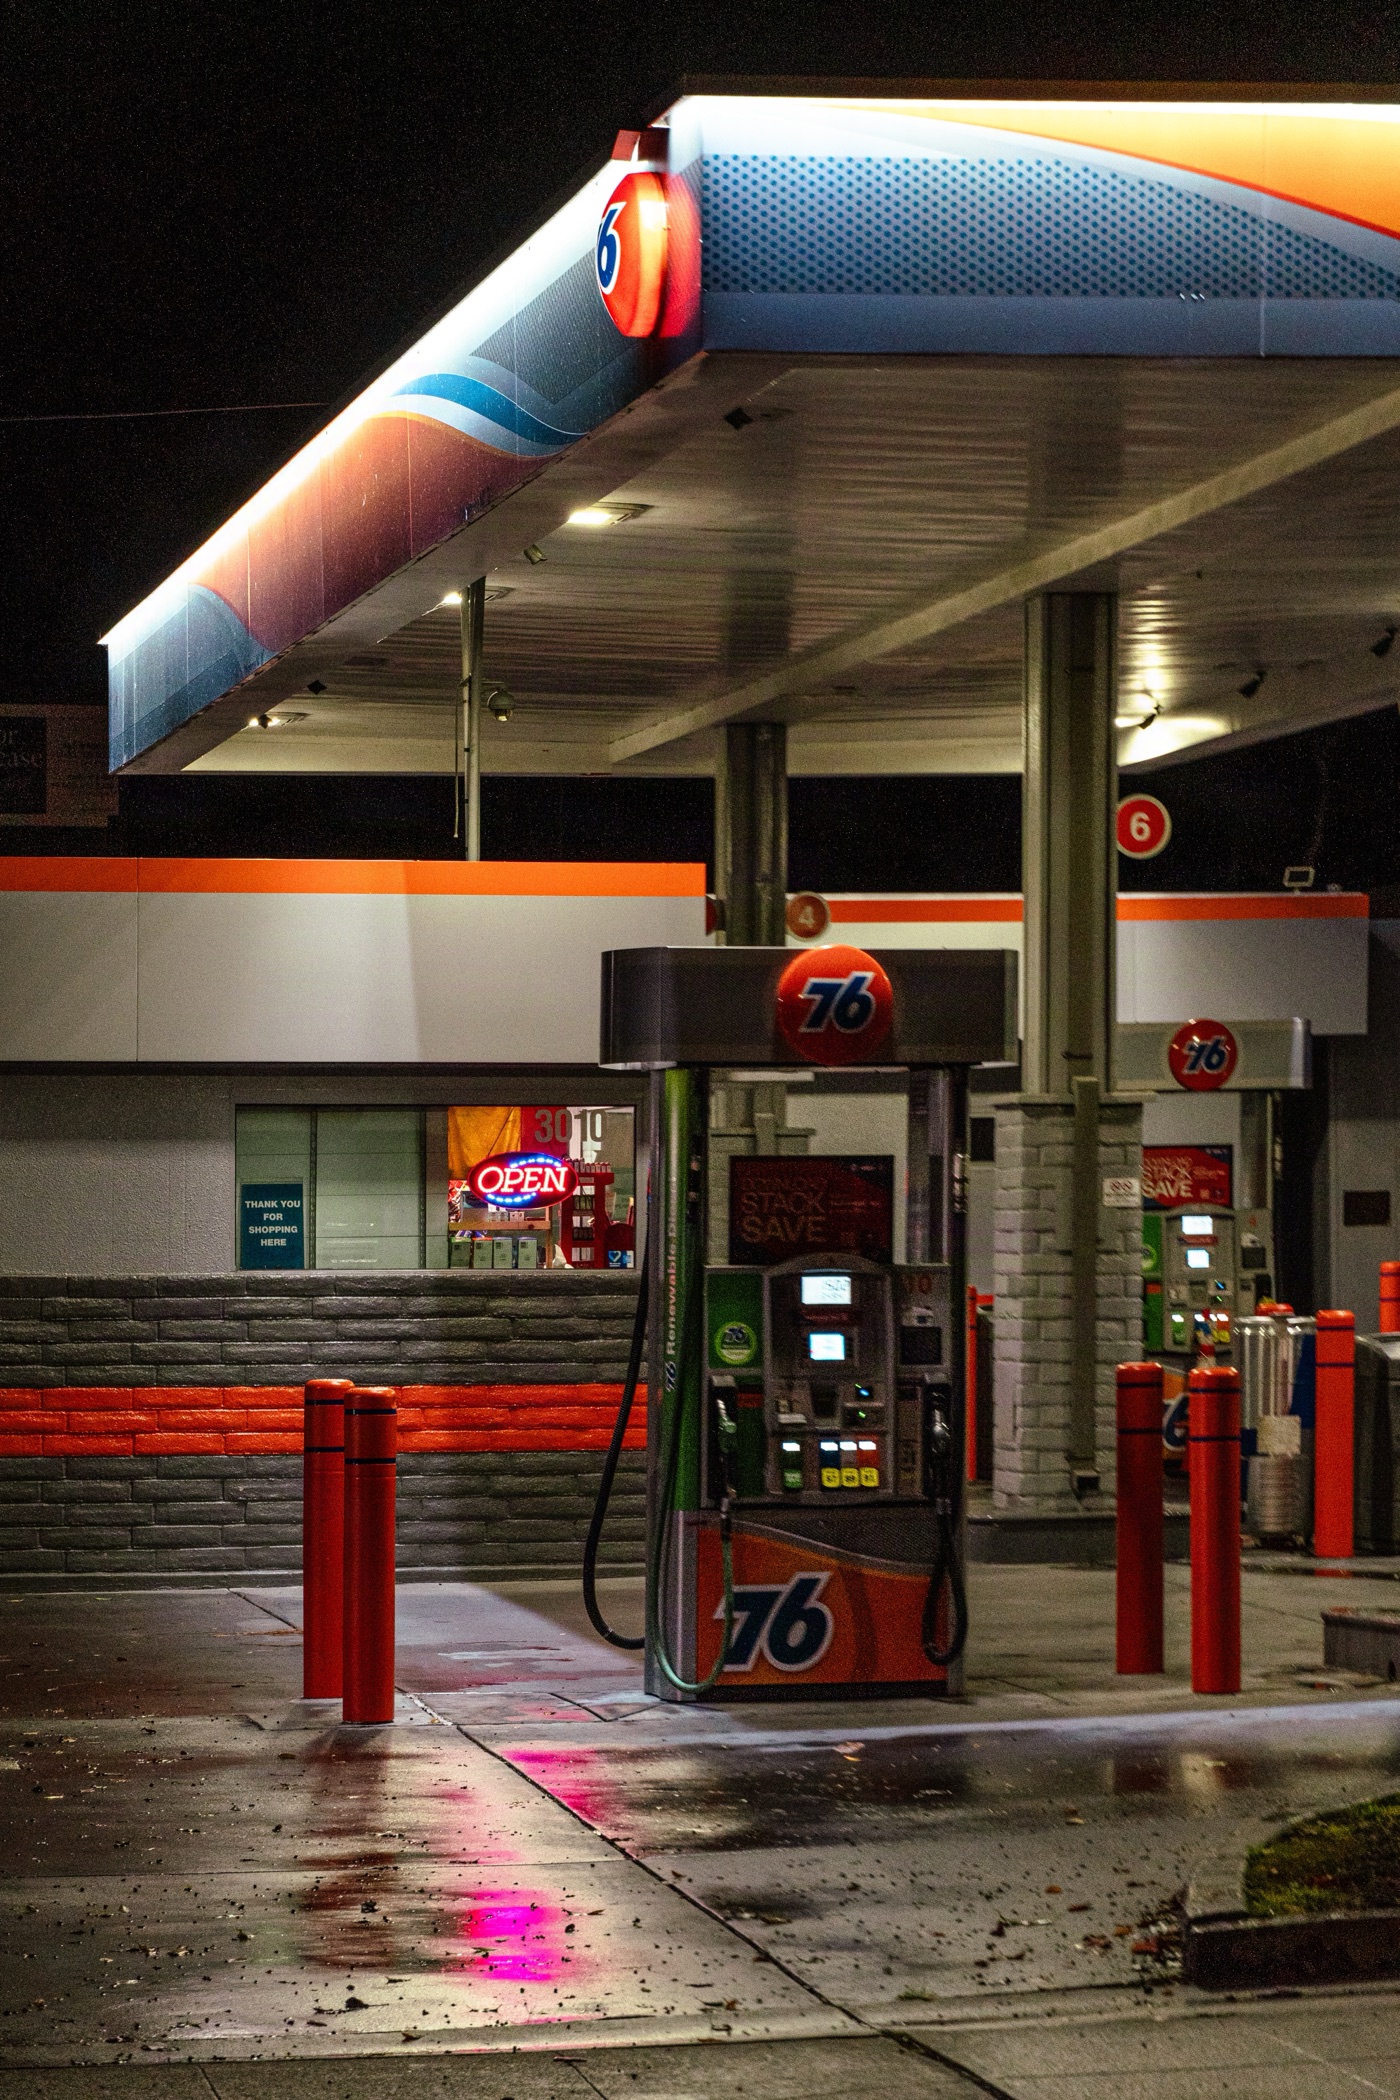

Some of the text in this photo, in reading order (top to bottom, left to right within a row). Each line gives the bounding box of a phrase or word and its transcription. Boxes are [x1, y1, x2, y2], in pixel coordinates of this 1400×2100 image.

[596, 201, 627, 294] 6
[1129, 811, 1151, 841] 6
[798, 905, 816, 928] 4
[799, 971, 876, 1033] 76
[1182, 1034, 1228, 1074] 76
[534, 1109, 608, 1143] 3010
[478, 1166, 568, 1193] OPEN
[1141, 1180, 1194, 1198] SAVE
[245, 1200, 301, 1208] THANK YOU
[741, 1191, 826, 1214] STACK
[248, 1226, 298, 1234] SHOPPING
[263, 1213, 283, 1221] FOR
[741, 1215, 828, 1243] SAVE
[260, 1239, 287, 1247] HERE
[905, 1273, 932, 1295] 10
[667, 1245, 677, 1356] Renewable
[665, 1361, 677, 1393] 76
[713, 1571, 834, 1672] 76
